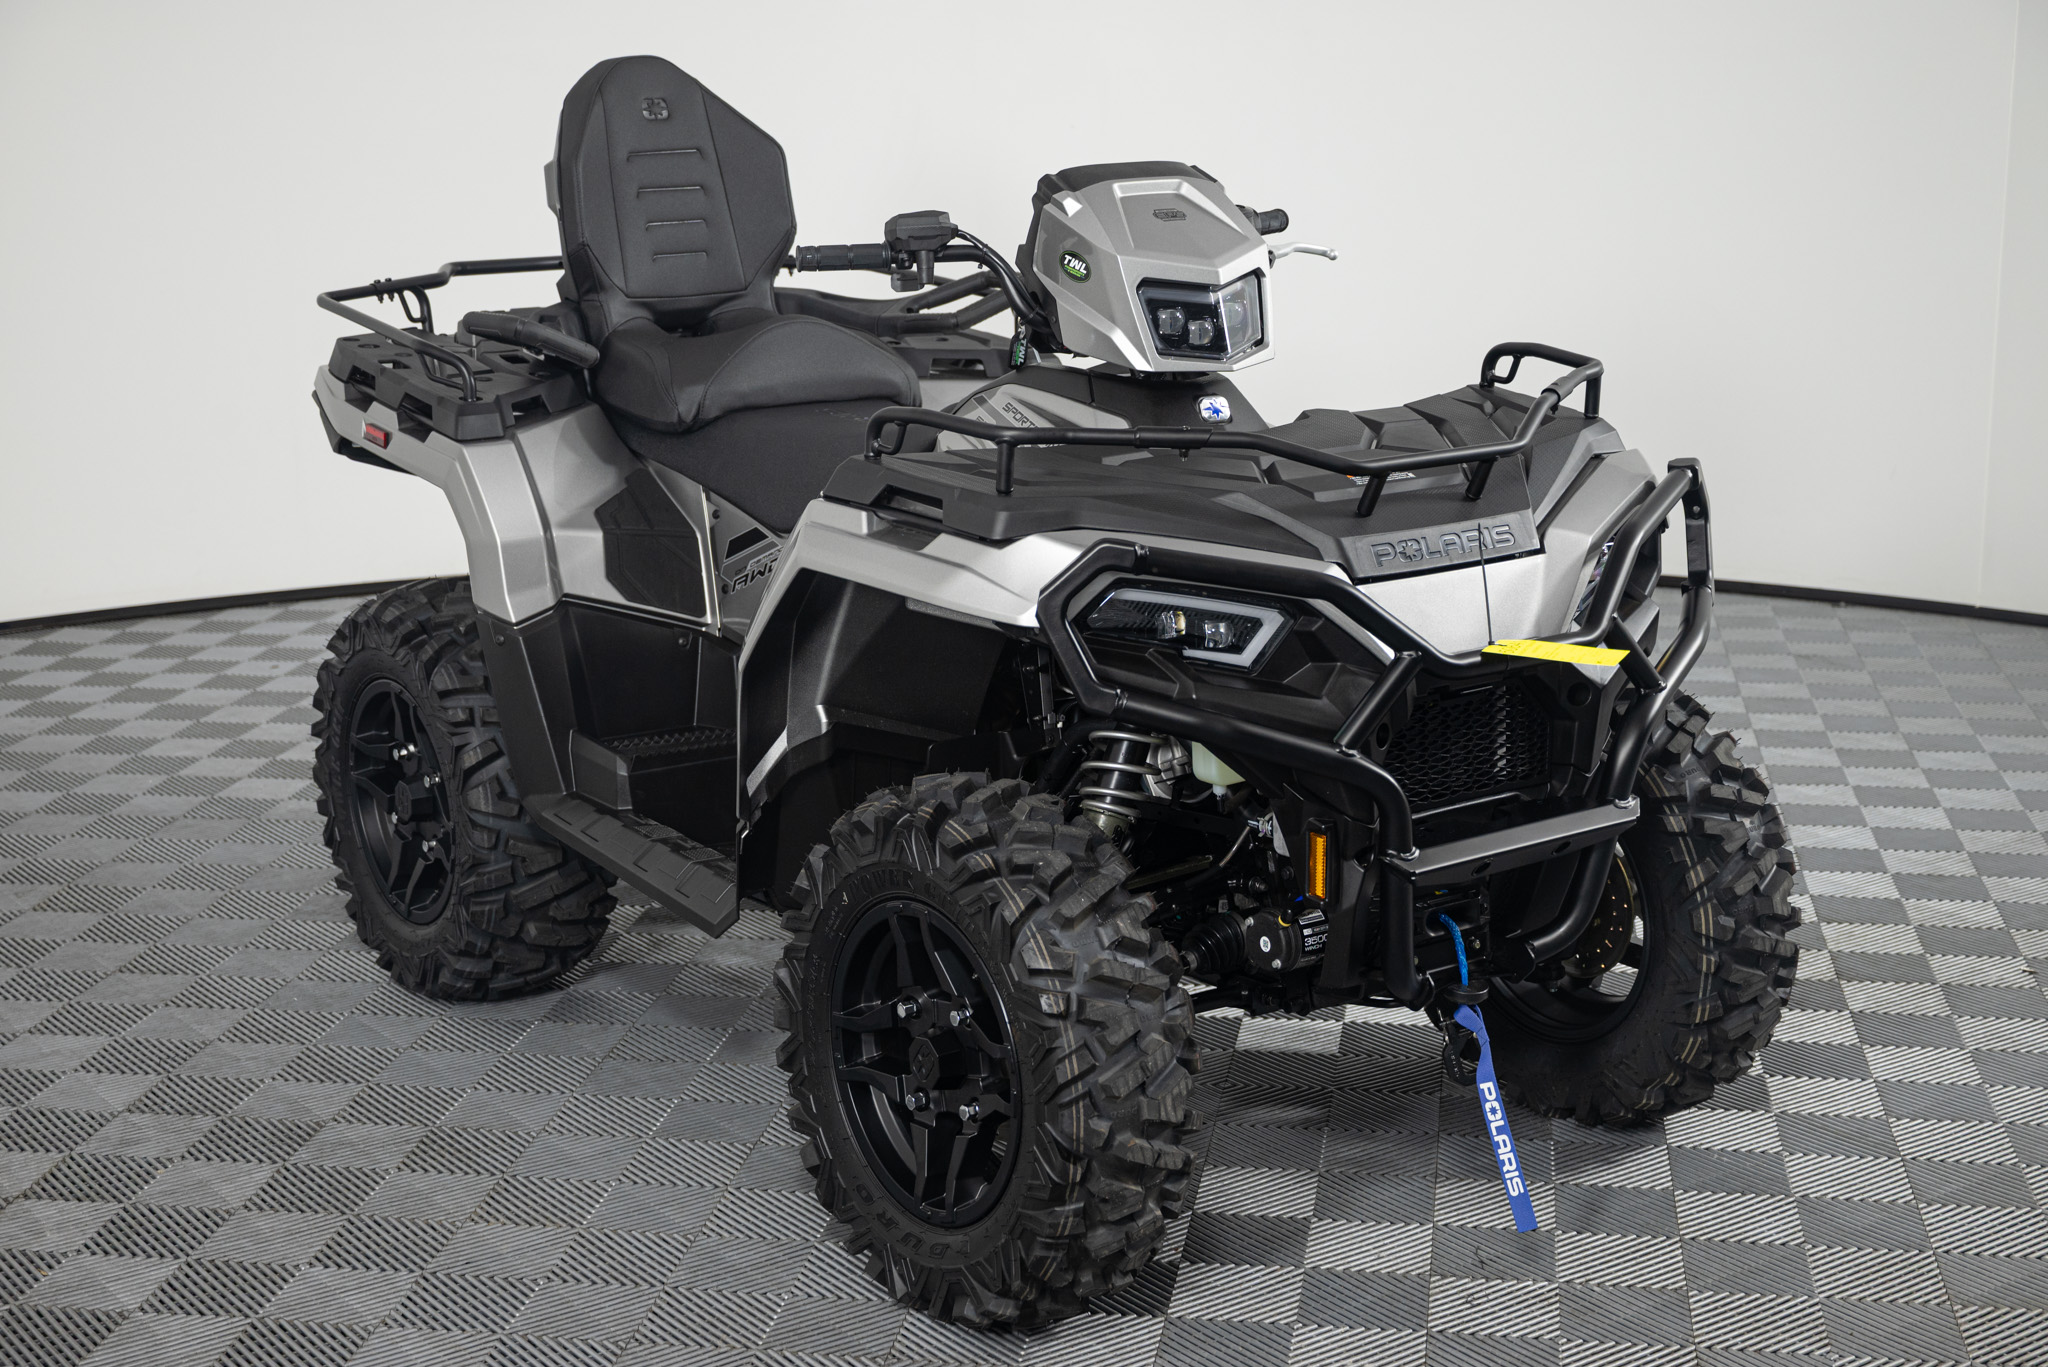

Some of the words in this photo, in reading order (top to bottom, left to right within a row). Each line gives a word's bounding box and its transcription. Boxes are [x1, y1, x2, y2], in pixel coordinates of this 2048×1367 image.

[1064, 254, 1087, 274] TWL
[1018, 338, 1027, 366] TWL
[1002, 402, 1040, 429] SPORT
[1370, 524, 1516, 567] POLARIS
[1480, 1081, 1524, 1196] POLARIS
